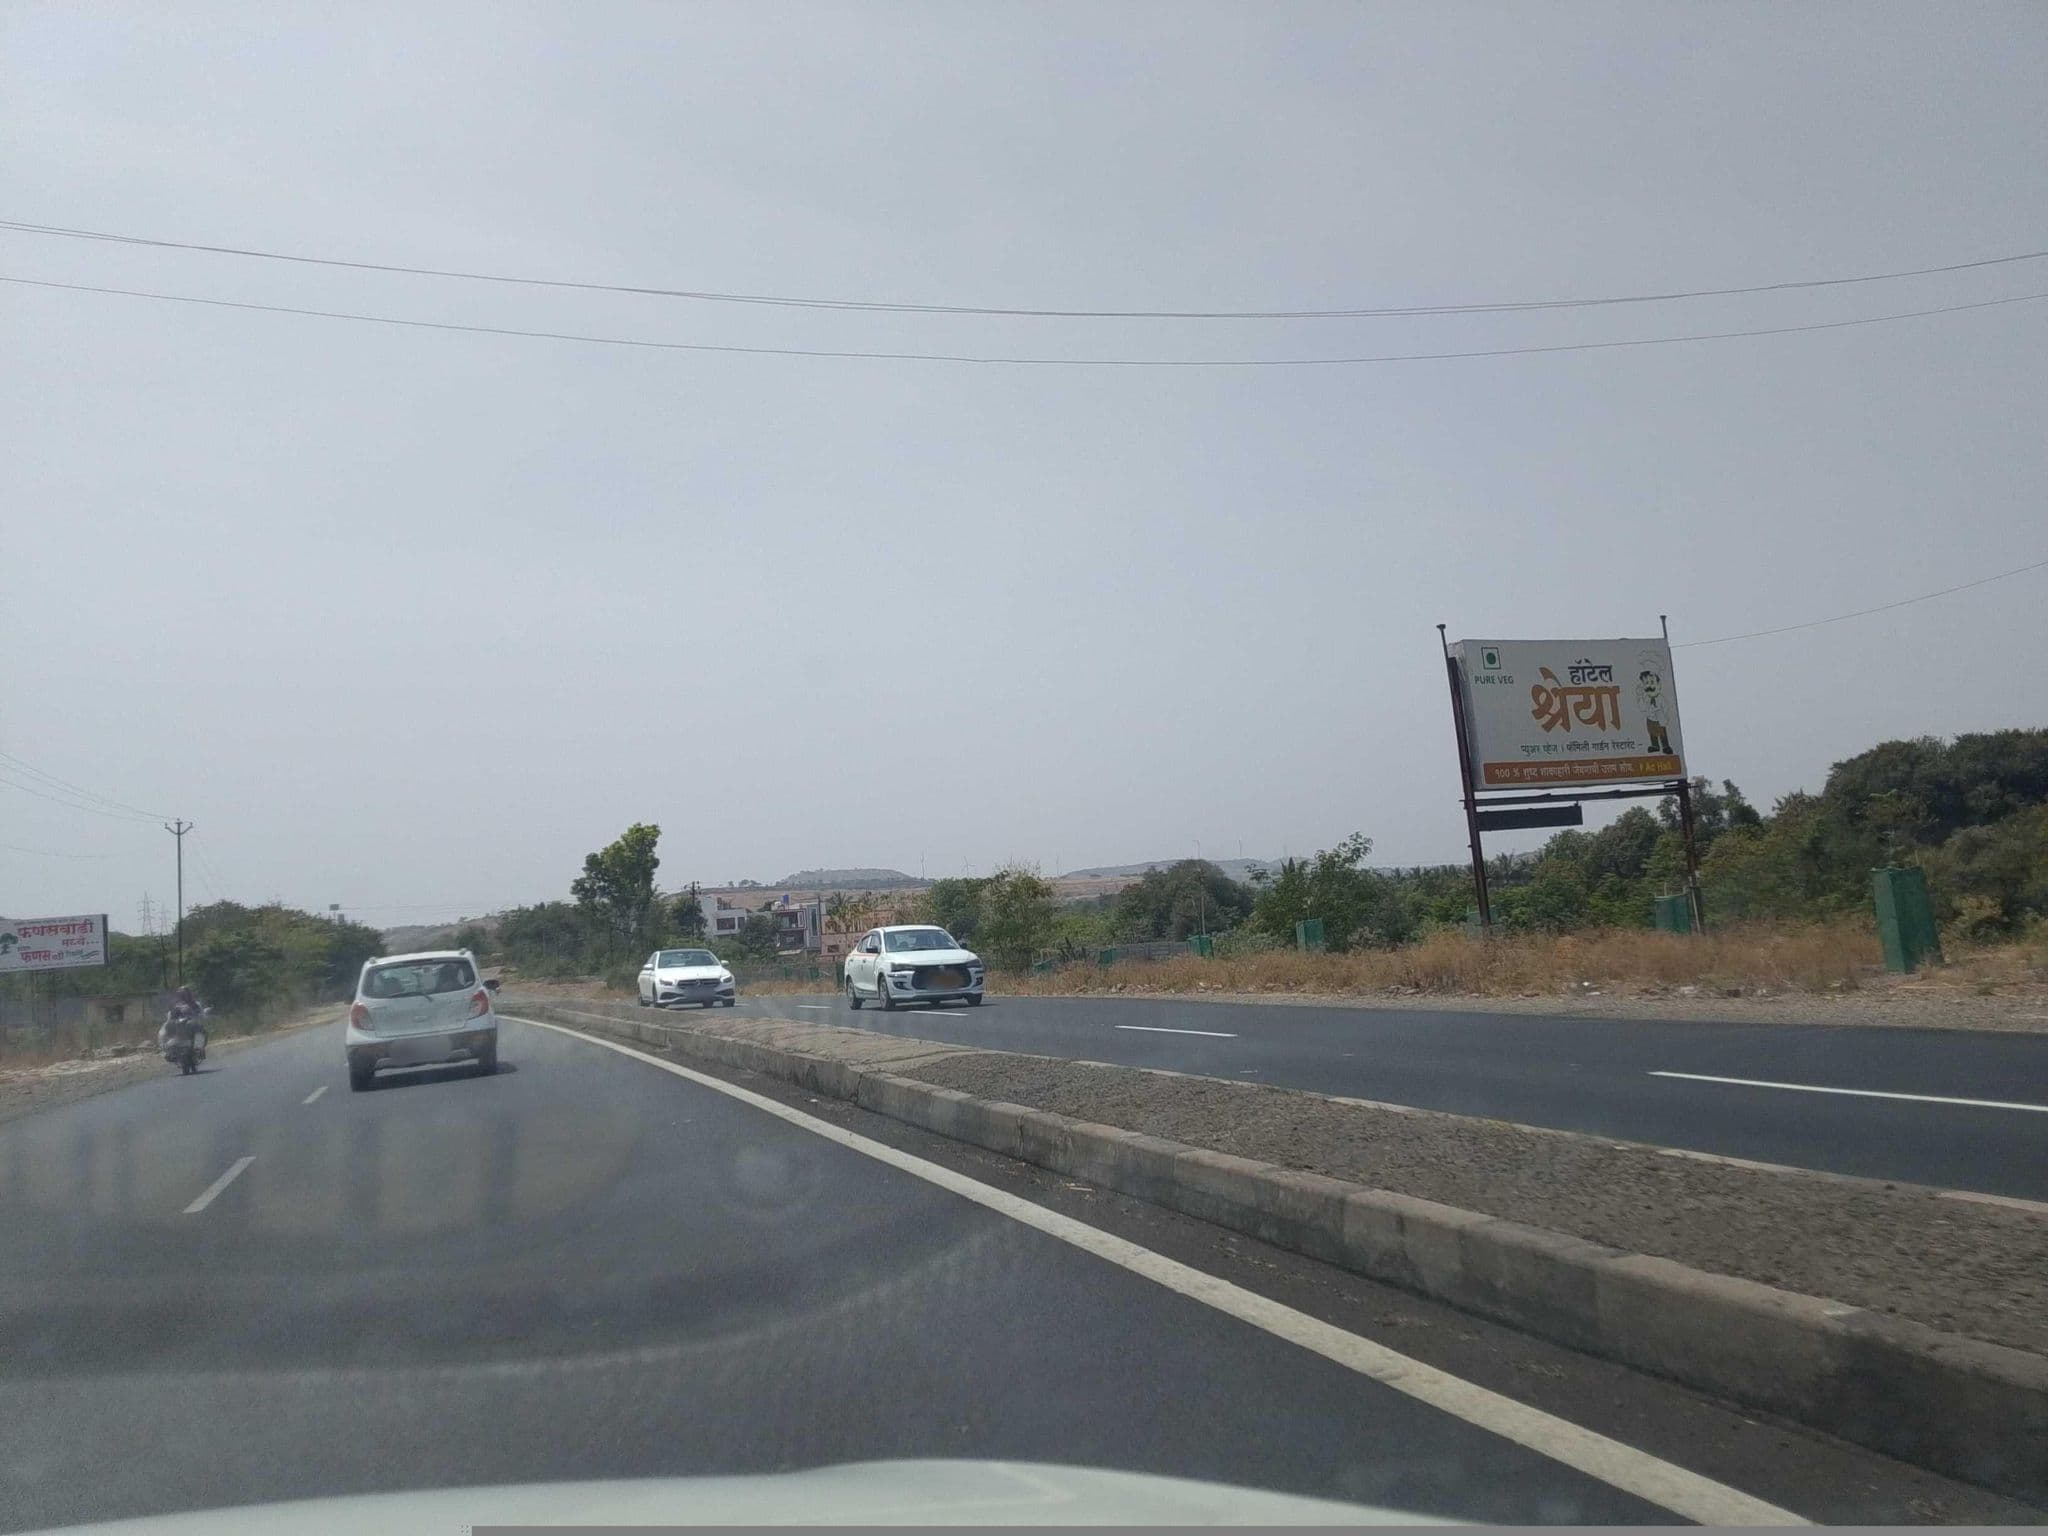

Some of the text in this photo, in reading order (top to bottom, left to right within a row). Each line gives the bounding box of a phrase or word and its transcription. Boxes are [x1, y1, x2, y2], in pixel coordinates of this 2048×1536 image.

[1474, 675, 1514, 685] PURE VEG
[1568, 658, 1613, 685] हॉटेल
[1531, 667, 1621, 733] श्रेया
